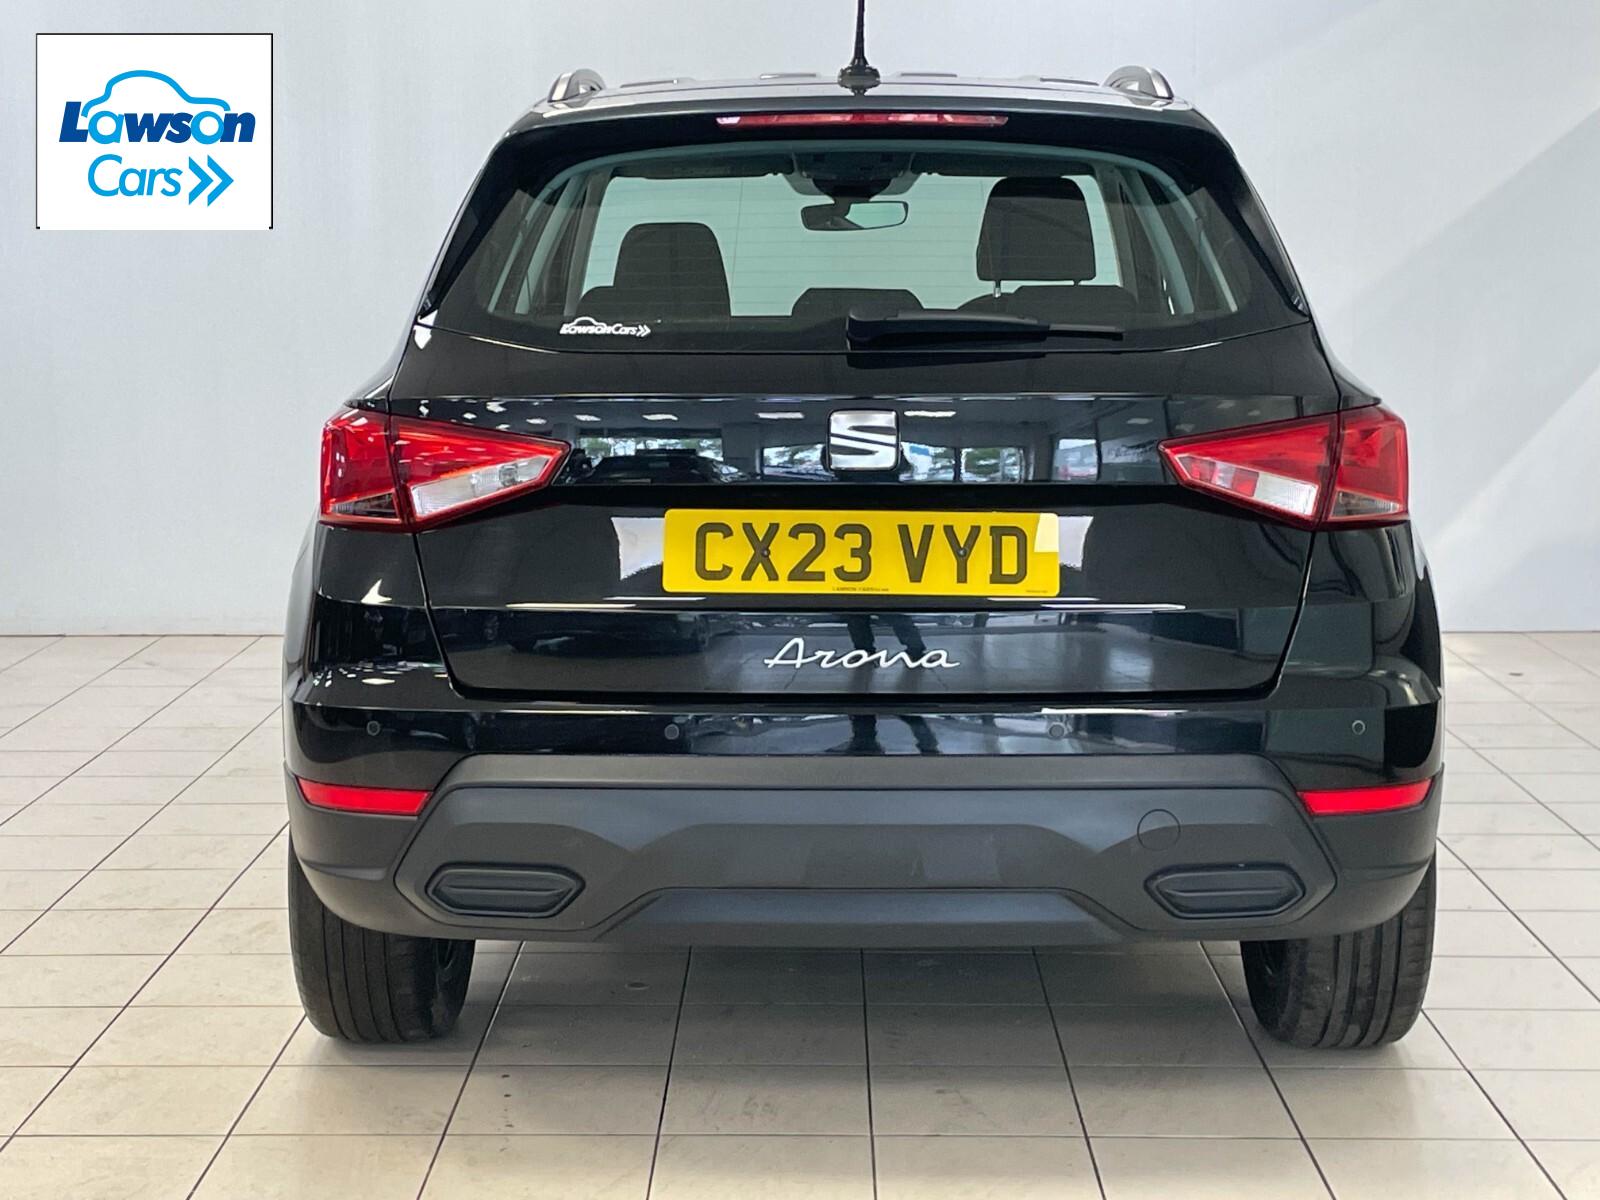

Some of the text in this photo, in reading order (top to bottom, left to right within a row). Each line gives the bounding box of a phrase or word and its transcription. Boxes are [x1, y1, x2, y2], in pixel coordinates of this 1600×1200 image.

[695, 522, 1028, 585] CX23 VYD
[764, 637, 960, 669] Arona
